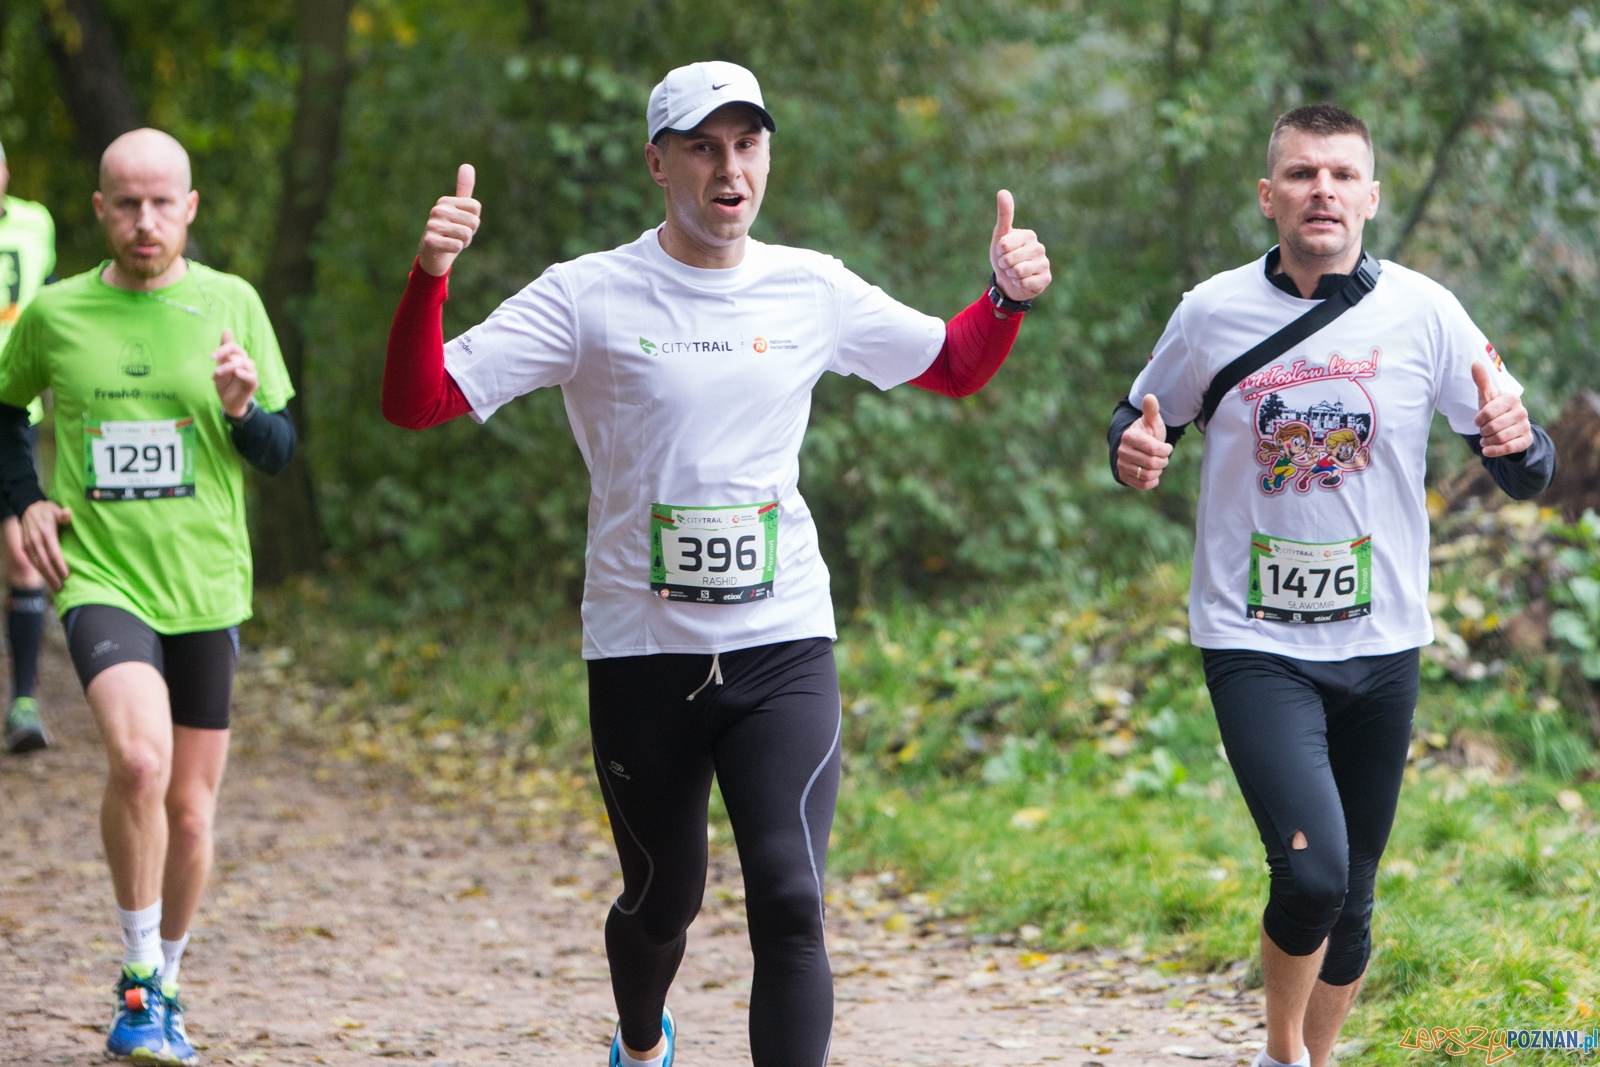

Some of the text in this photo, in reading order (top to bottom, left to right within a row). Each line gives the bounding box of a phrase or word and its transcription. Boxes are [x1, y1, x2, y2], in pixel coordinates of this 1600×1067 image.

[1328, 349, 1379, 382] biega!
[105, 444, 176, 474] 1291
[678, 535, 756, 572] 396
[702, 576, 738, 586] RASHID
[1267, 564, 1355, 598] 1476
[1288, 600, 1335, 610] SŁAWOMIR
